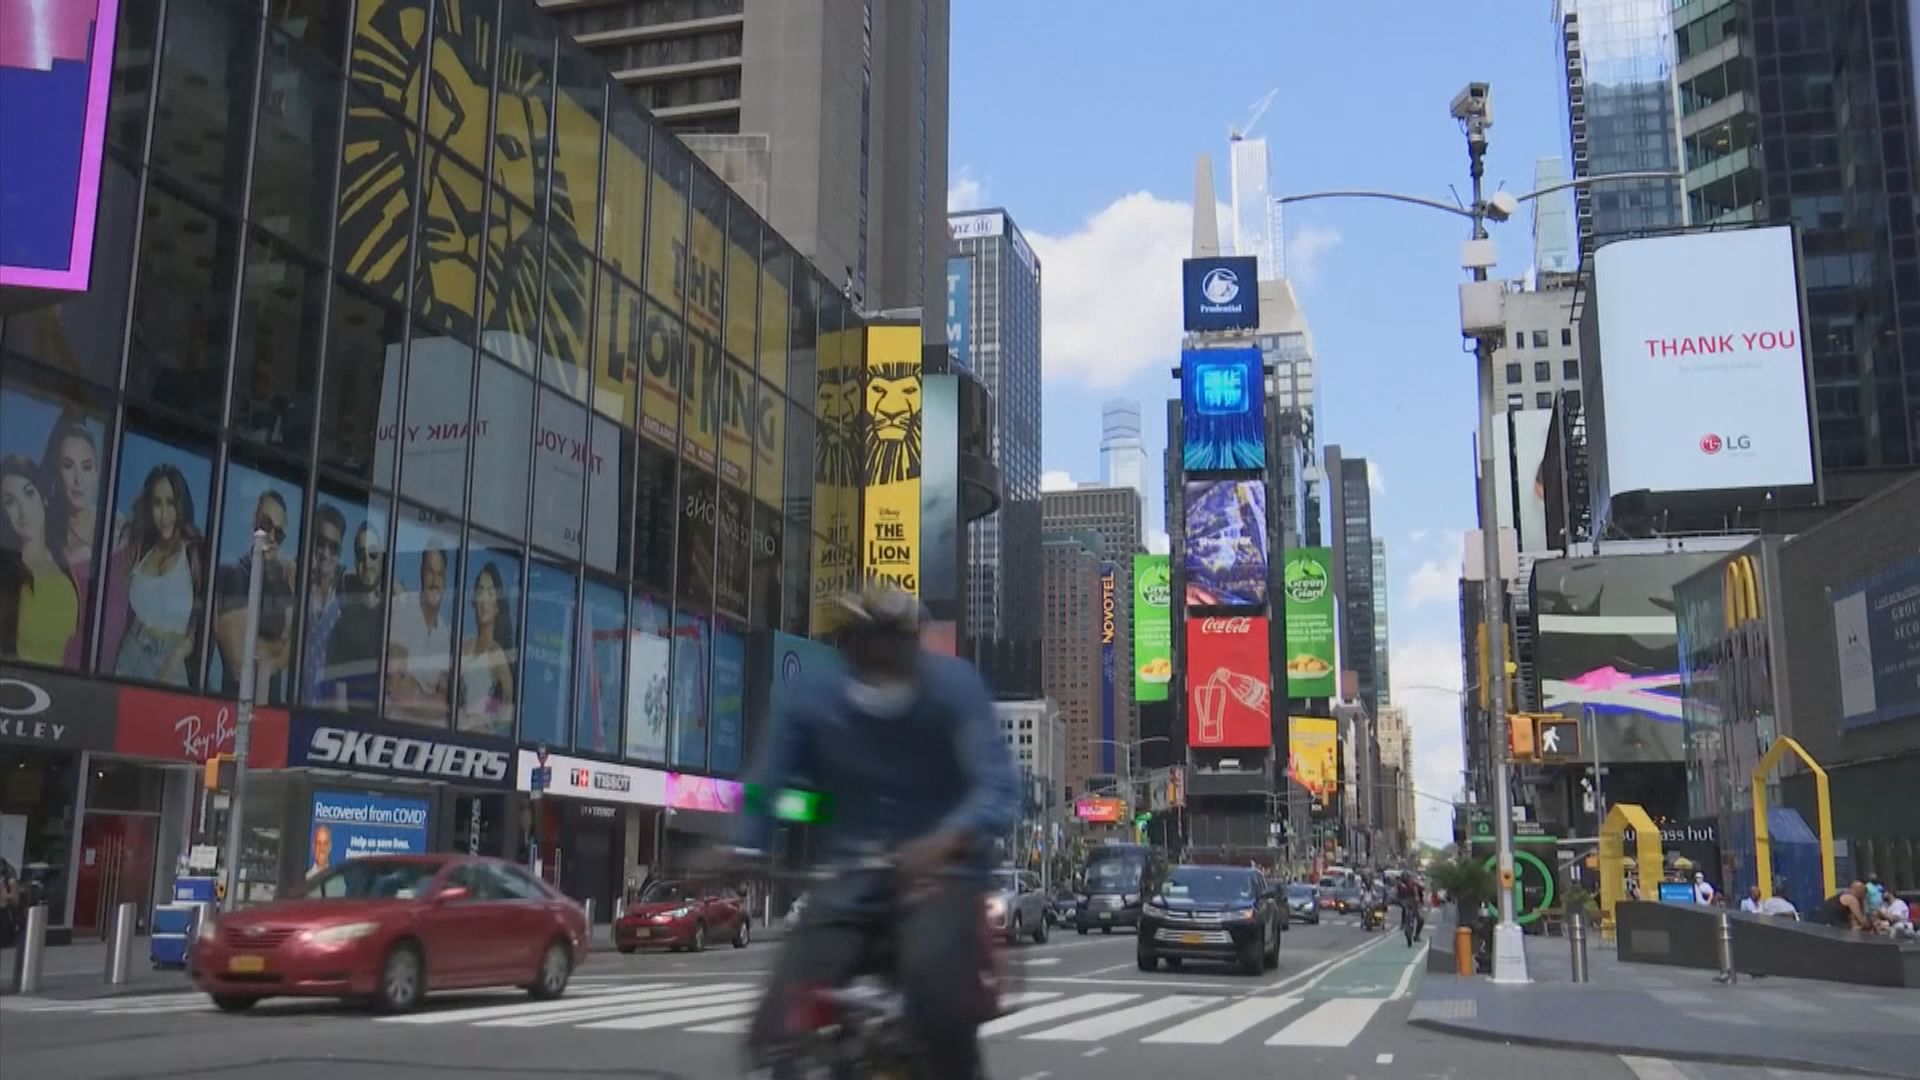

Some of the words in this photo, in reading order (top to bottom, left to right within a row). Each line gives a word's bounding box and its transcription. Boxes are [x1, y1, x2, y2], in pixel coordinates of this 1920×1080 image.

[1200, 303, 1243, 313] Prudential
[608, 258, 697, 401] LION
[700, 328, 776, 452] KING
[1646, 333, 1734, 358] THANK
[1742, 330, 1796, 351] YOU
[1726, 435, 1751, 450] LG
[874, 523, 904, 537] THE
[869, 540, 910, 565] LION
[866, 566, 916, 590] KING
[1288, 578, 1324, 589] Green
[1292, 588, 1324, 598] Giant
[1101, 571, 1115, 644] NOVOTEL
[174, 707, 237, 758] Ray-Ba
[306, 727, 510, 781] SKECHERS
[594, 771, 630, 792] TISSOT
[315, 802, 368, 821] Recovered
[369, 805, 393, 822] from
[393, 808, 427, 825] COVID?
[351, 836, 367, 849] Help
[1687, 825, 1714, 842] hut
